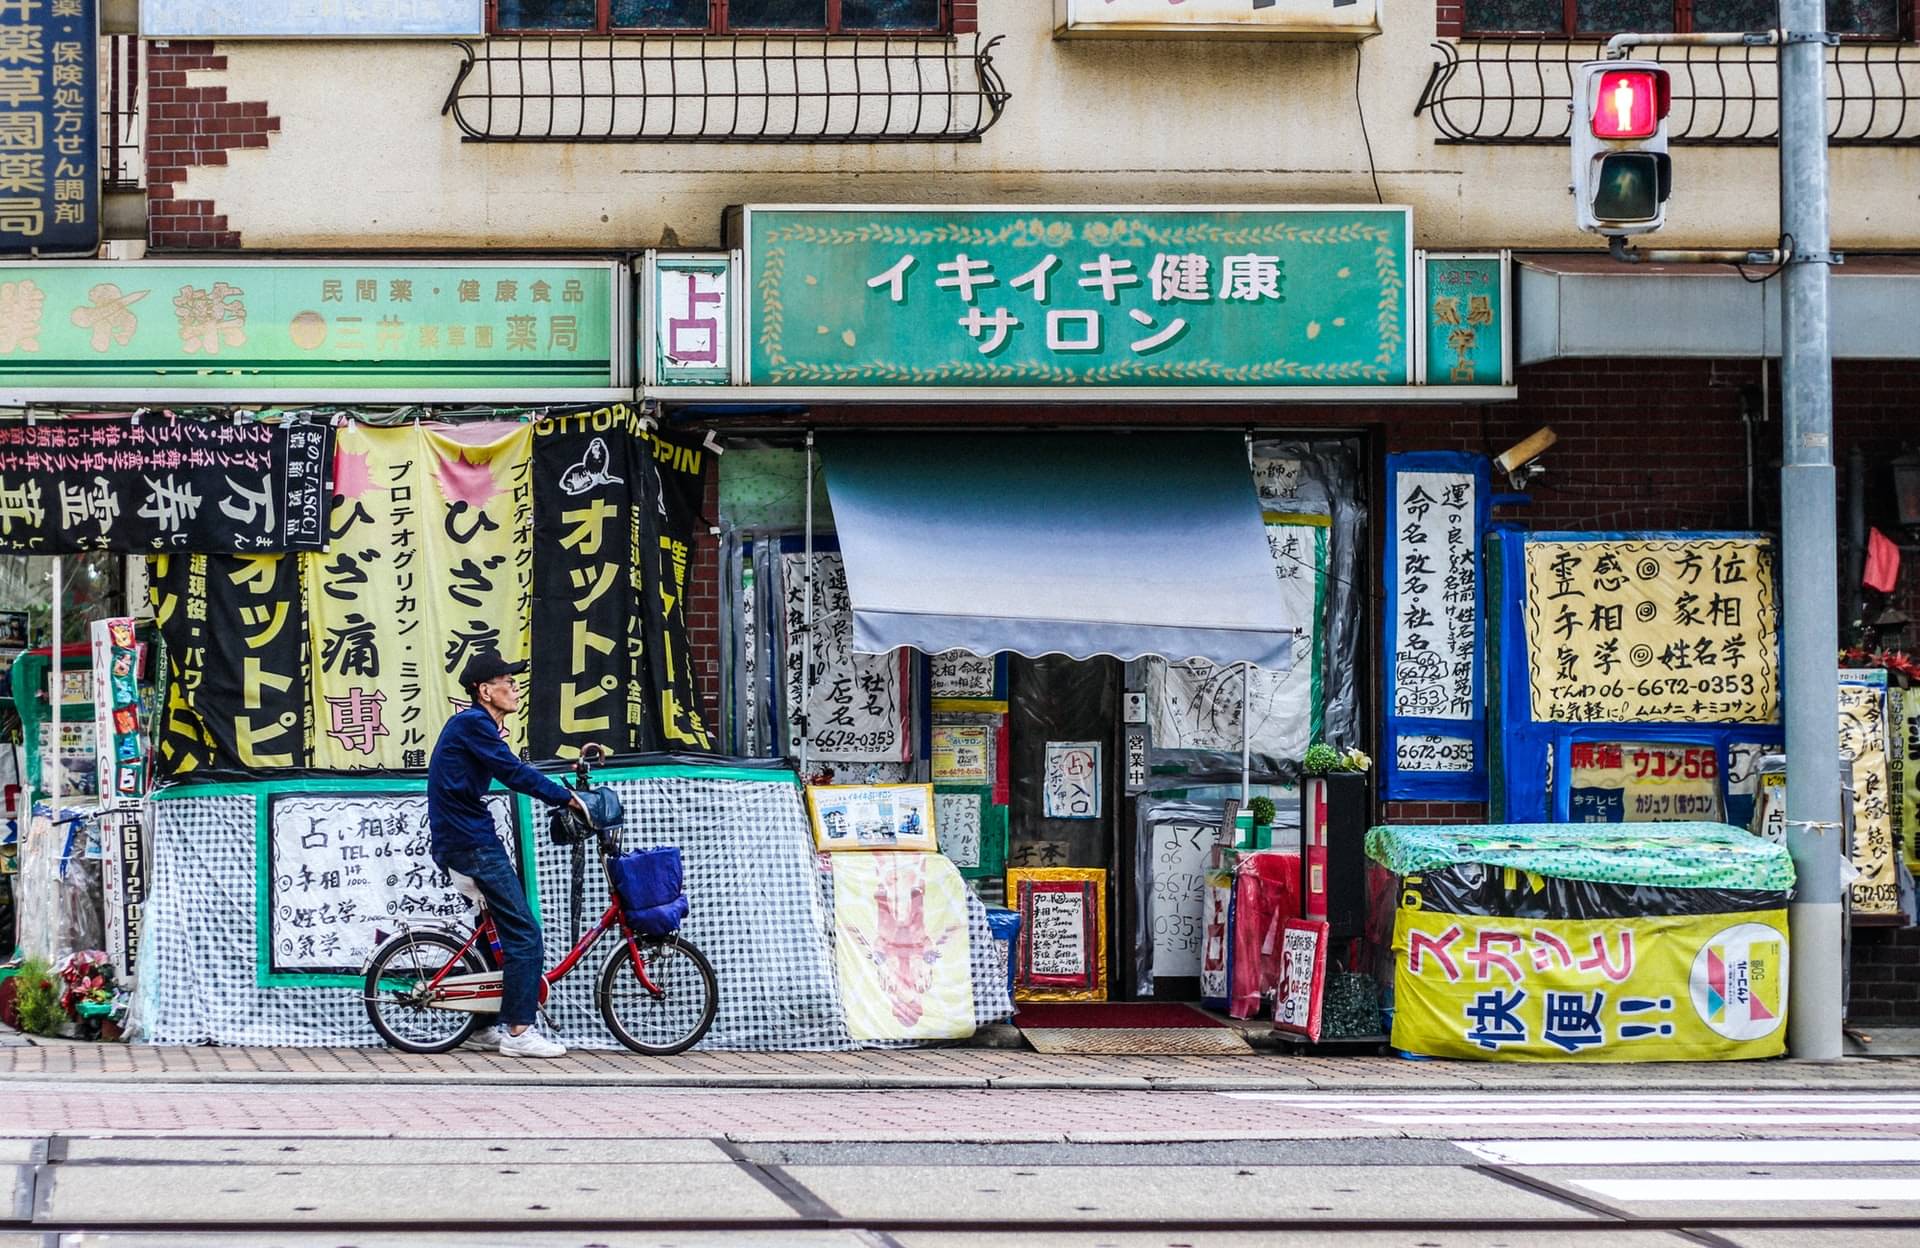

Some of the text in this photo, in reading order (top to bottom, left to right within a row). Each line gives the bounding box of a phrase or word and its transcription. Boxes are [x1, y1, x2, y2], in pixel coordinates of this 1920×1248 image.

[322, 279, 584, 302] 民間薬・健康食品
[867, 253, 1281, 301] イキイキ健康
[670, 275, 721, 363] 占
[959, 307, 1186, 353] サロン
[301, 432, 322, 535] きのこ「ASGC」
[1547, 550, 1748, 600] 霊感 方位
[389, 460, 426, 768] プロテオグリカン・ミラクル健
[1553, 591, 1742, 640] 手相 家相
[959, 661, 987, 675] 命名
[1399, 664, 1441, 679] 6672
[1419, 654, 1436, 665] 06
[1557, 633, 1746, 682] 気学 姓名学
[1399, 690, 1440, 705] 0353
[1550, 673, 1755, 699] でんわ 06-6672-0353
[792, 730, 895, 747] 0-6672-0353
[1068, 755, 1083, 775] 占
[1129, 735, 1145, 785] 営業中
[1571, 744, 1622, 769] 原種
[1070, 783, 1091, 813] 入口
[1573, 795, 1617, 806] 今テレビ
[340, 842, 433, 860] TEL 06-66
[297, 863, 341, 891] 手相
[291, 899, 357, 928] 姓名学
[298, 932, 341, 959] 気学
[1410, 926, 1635, 982] スカッと
[1737, 961, 1748, 1005] イサコール
[1465, 990, 1675, 1051] 快便!!
